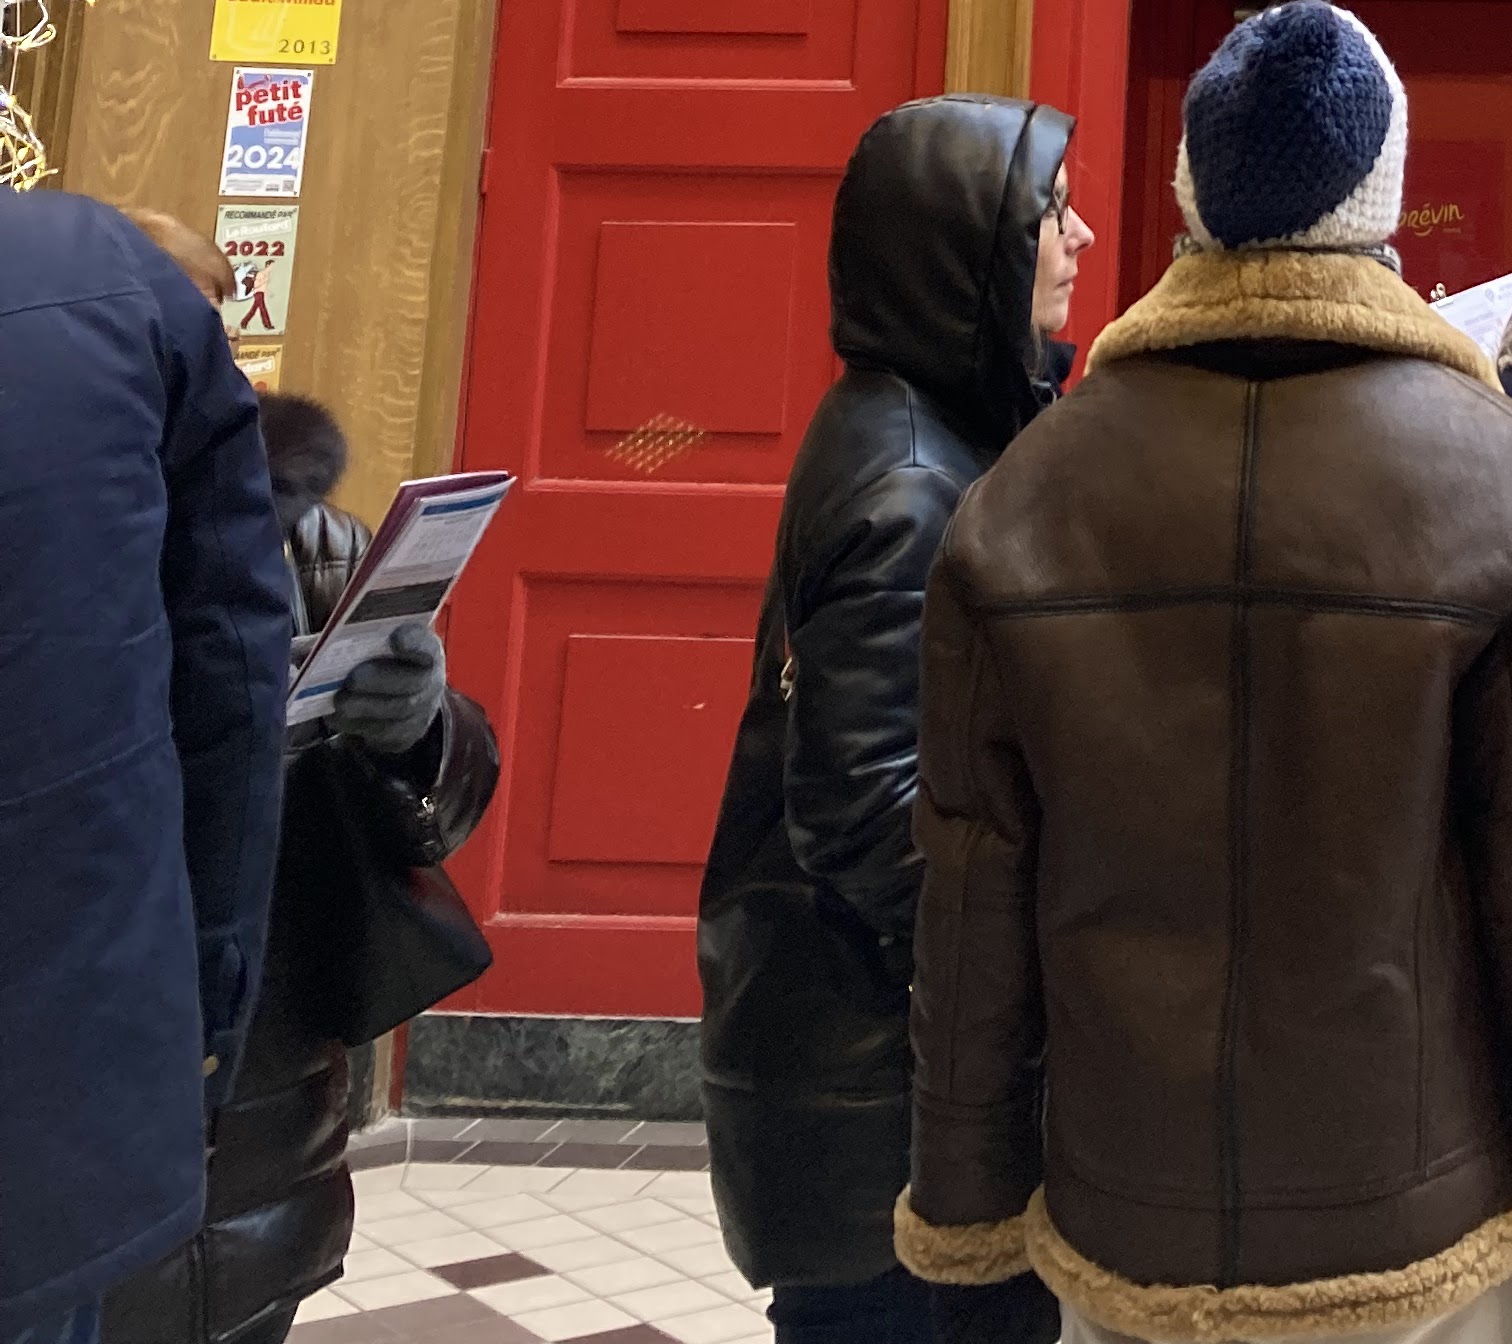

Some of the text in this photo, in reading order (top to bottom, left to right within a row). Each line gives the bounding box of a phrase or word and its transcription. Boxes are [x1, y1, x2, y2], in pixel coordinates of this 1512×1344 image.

[279, 40, 331, 55] 2013
[236, 79, 302, 111] petit
[248, 101, 303, 125] futé
[226, 145, 301, 169] 2024
[225, 241, 285, 256] 2022
